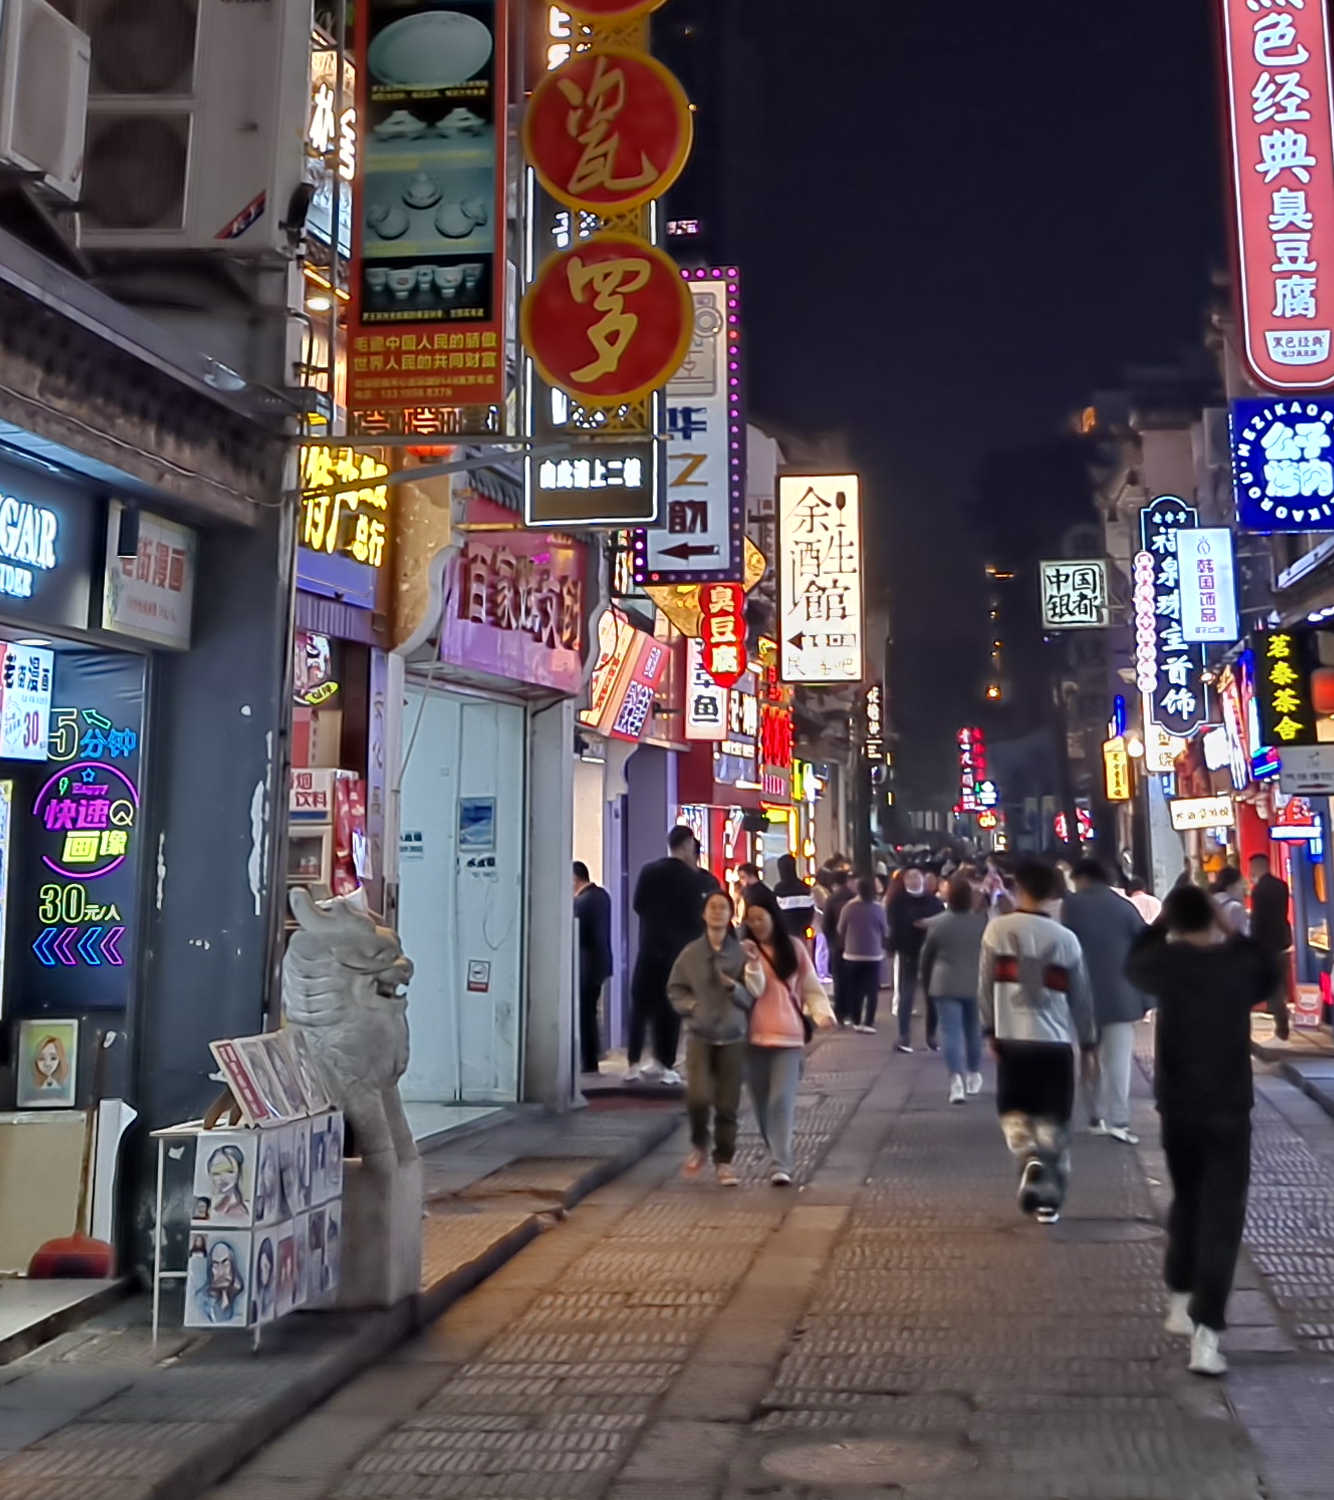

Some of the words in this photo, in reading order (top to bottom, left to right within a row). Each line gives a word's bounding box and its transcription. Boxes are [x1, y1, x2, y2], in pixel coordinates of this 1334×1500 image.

[1046, 568, 1098, 594] 中国
[1046, 592, 1103, 620] 银都
[708, 587, 739, 673] 臭豆腐
[62, 830, 128, 863] 画像
[39, 884, 121, 924] 30元/人
